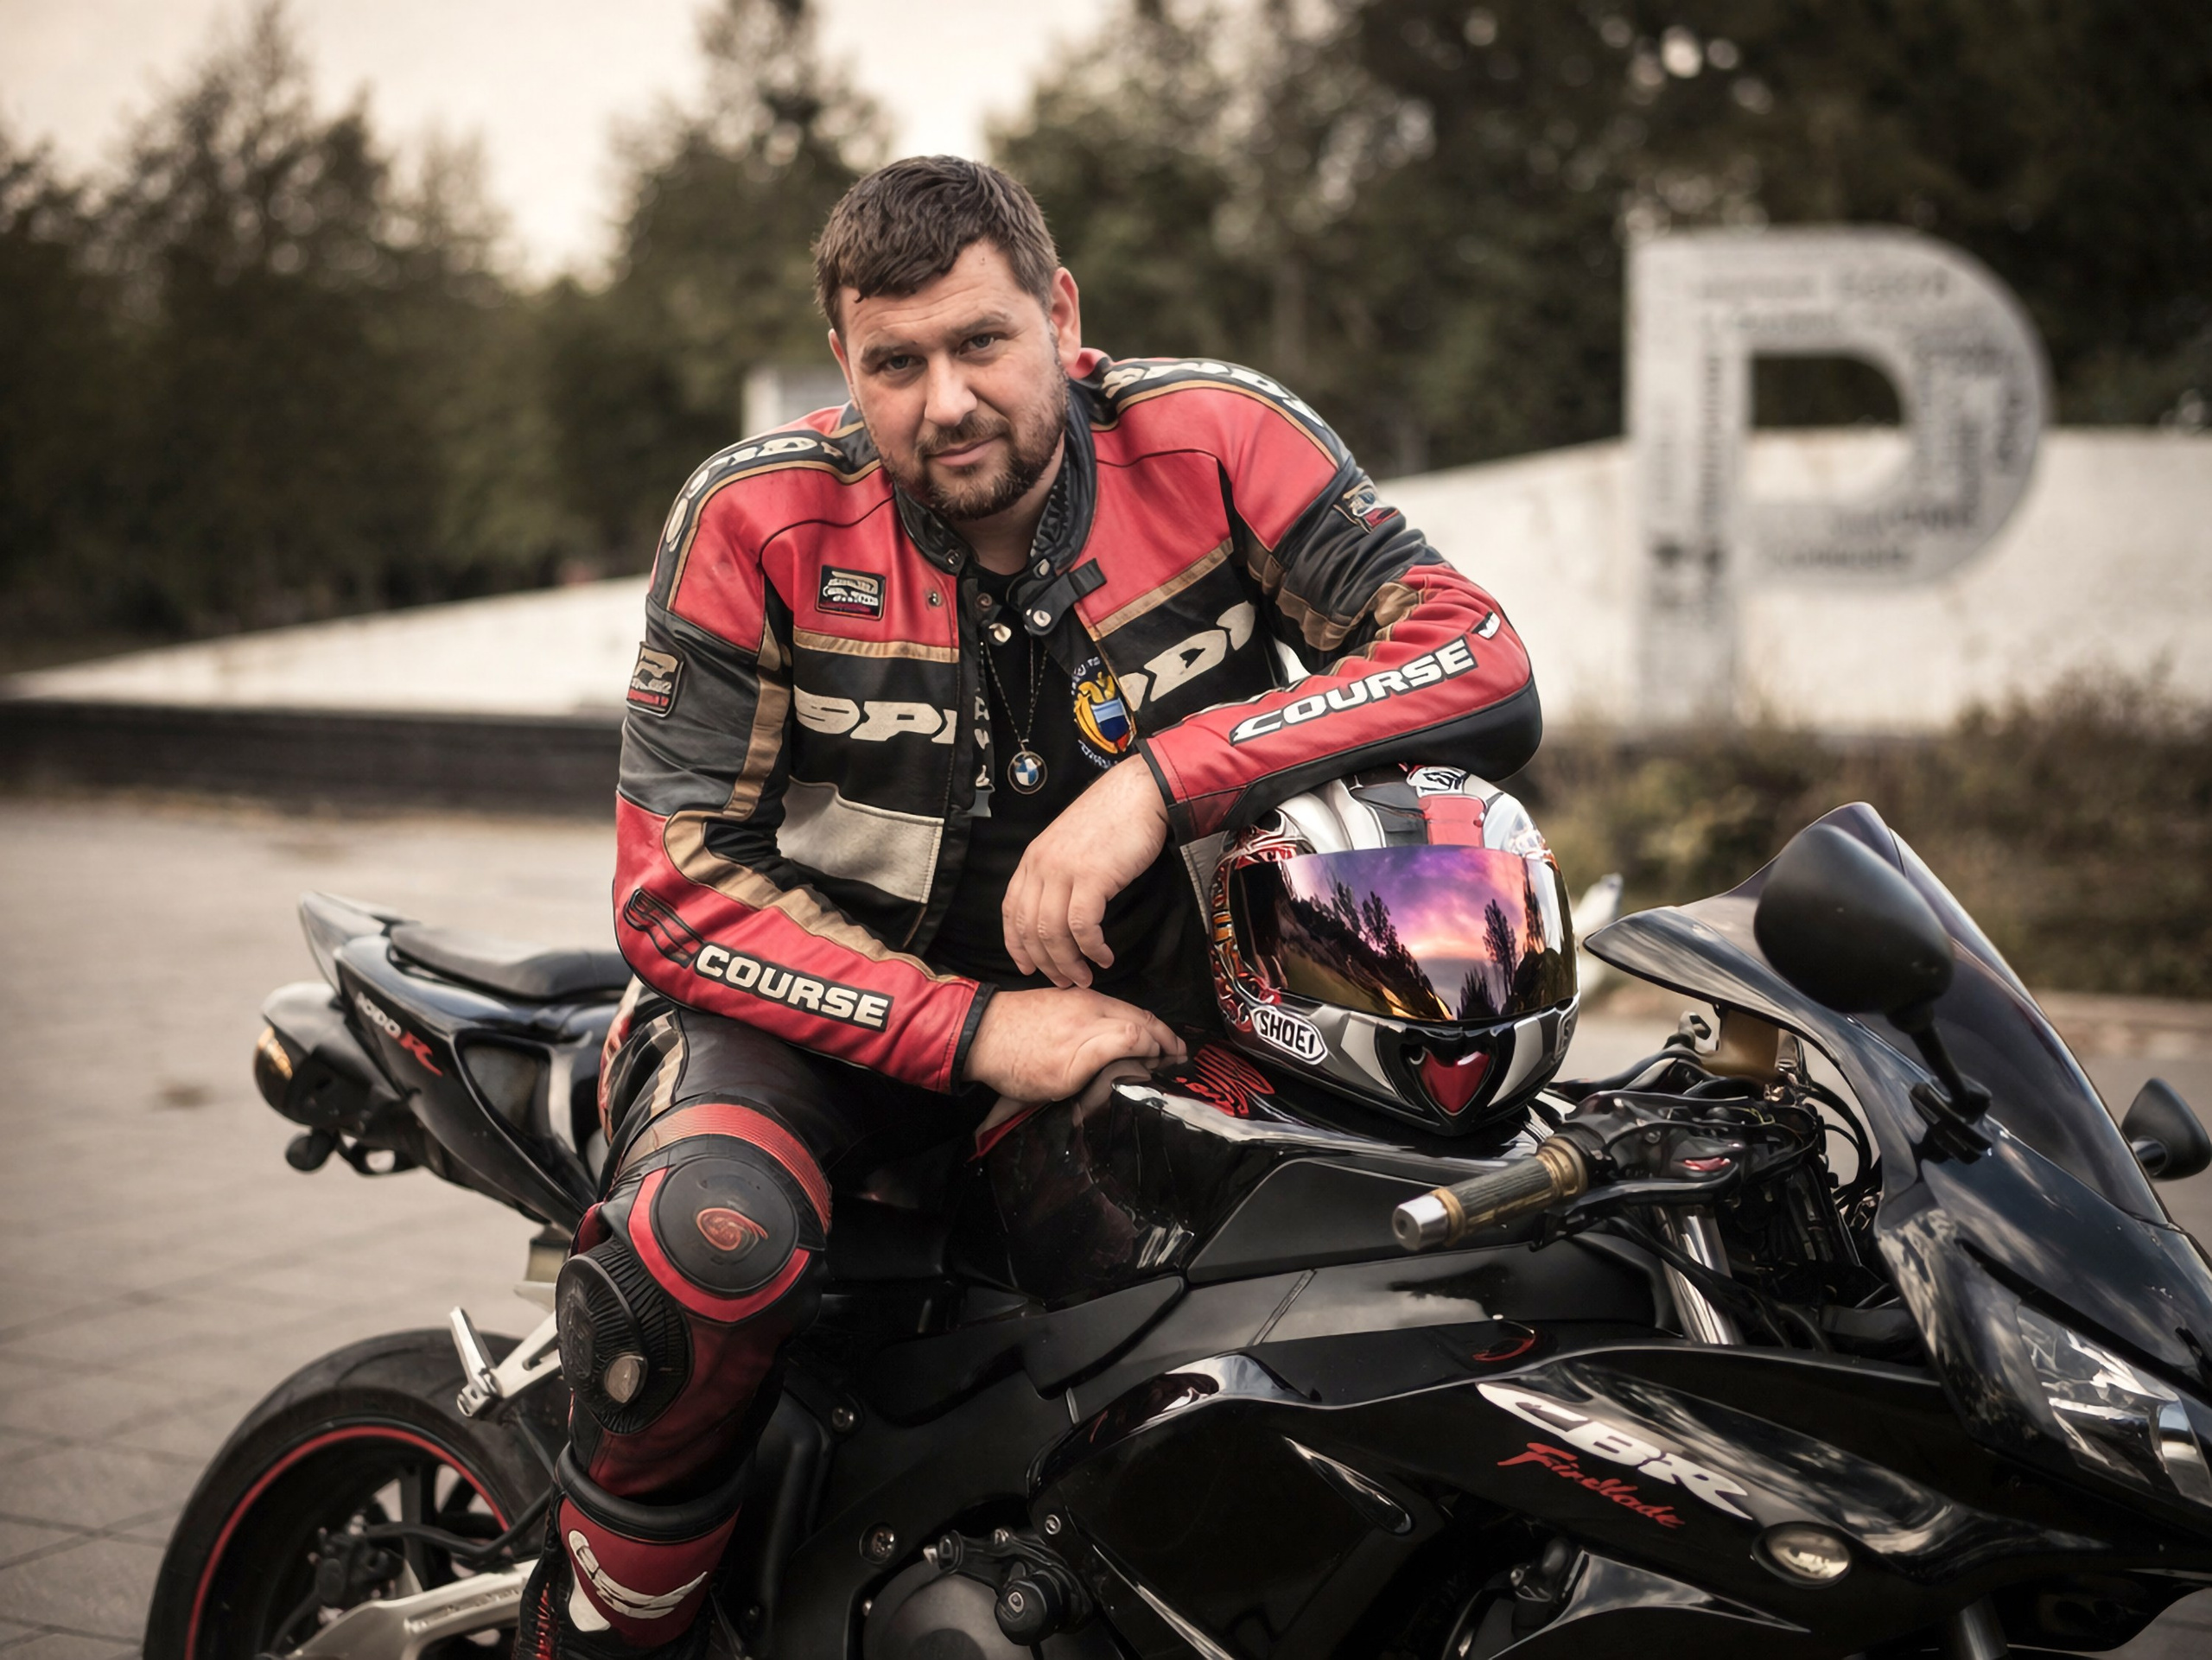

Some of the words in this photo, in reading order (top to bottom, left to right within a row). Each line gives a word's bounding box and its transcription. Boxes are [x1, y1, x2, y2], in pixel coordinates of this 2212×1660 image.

[1230, 637, 1477, 743] COURSE
[696, 943, 890, 1029] COURSE
[1258, 1010, 1316, 1054] SHOEI
[1476, 1383, 1754, 1522] CBR
